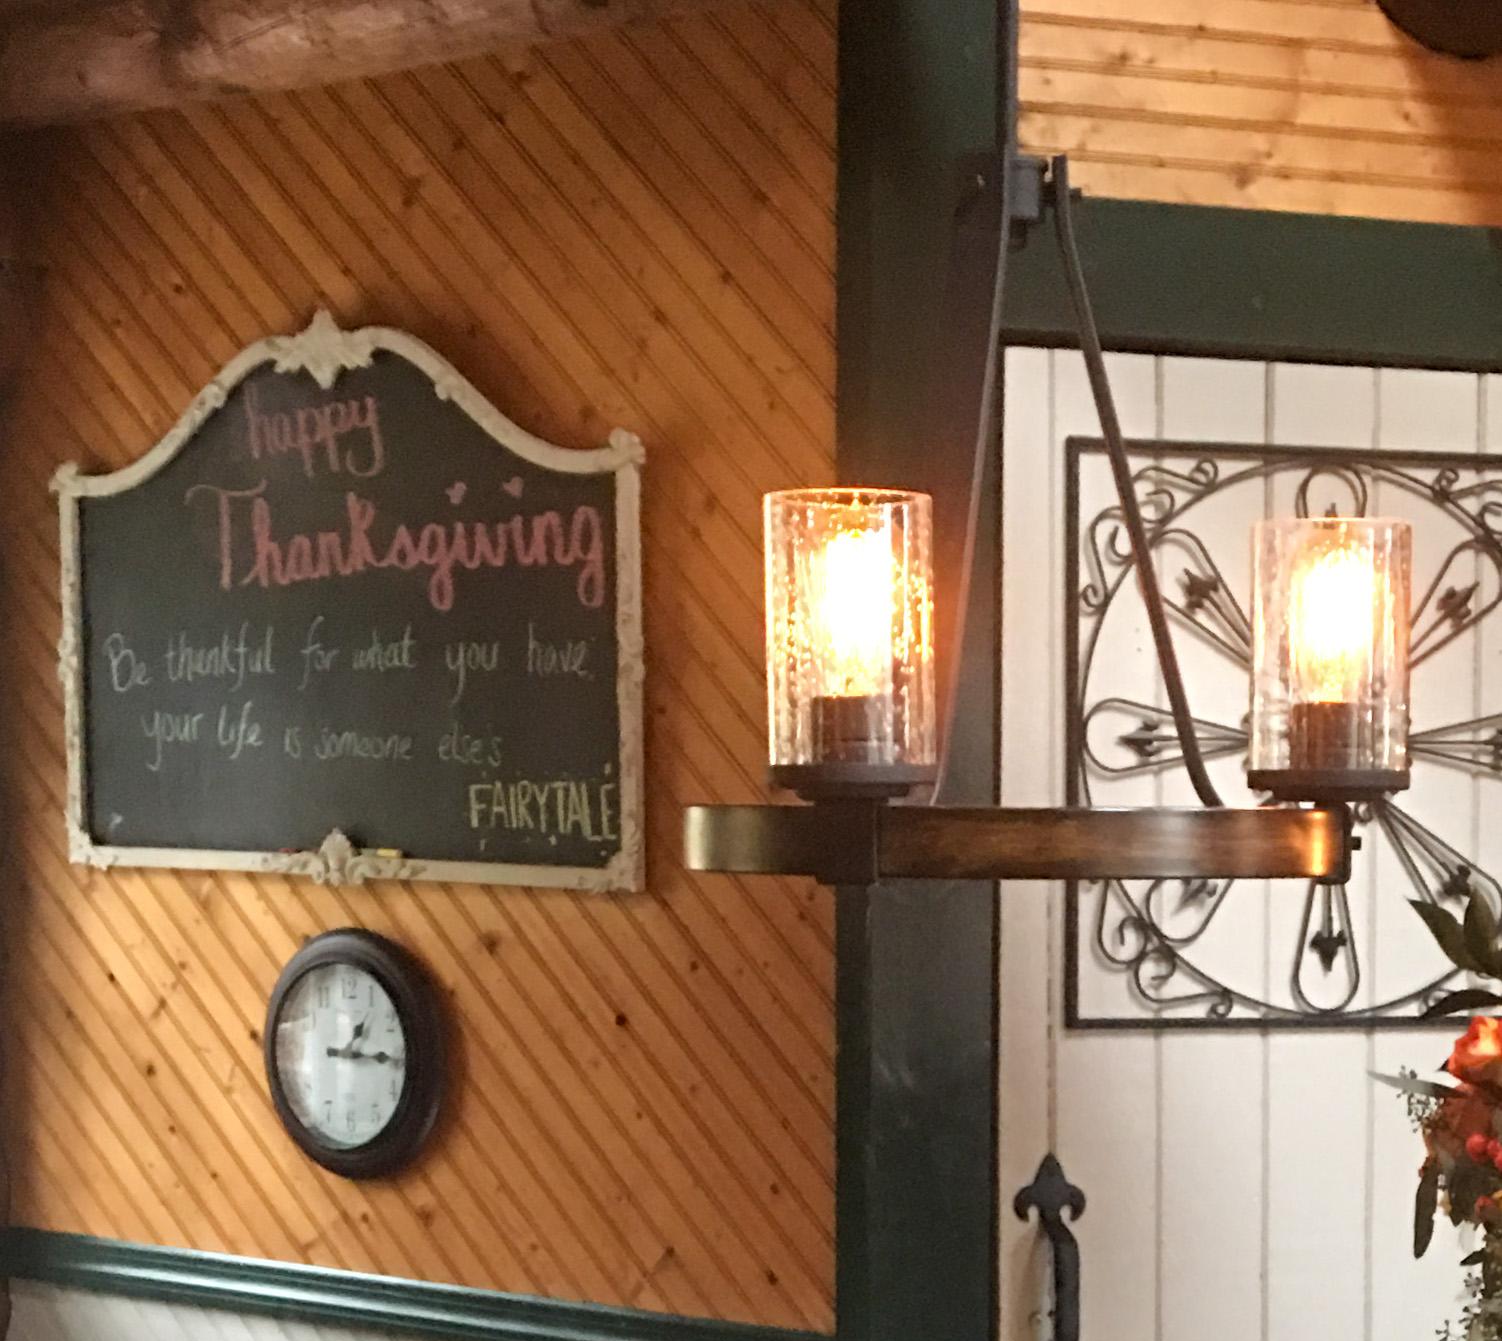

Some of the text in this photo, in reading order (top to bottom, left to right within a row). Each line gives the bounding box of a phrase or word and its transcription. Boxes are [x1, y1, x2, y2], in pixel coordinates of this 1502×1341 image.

[244, 382, 386, 478] happy
[185, 477, 605, 611] Thanksgiving
[105, 632, 150, 693] Be
[164, 622, 275, 692] thankful
[300, 616, 340, 690] for
[352, 624, 416, 672] what
[445, 641, 500, 704] you
[141, 710, 204, 772] your
[217, 701, 264, 760] life
[284, 723, 302, 760] is
[313, 727, 414, 761] someone
[469, 780, 619, 843] FAIRYTALE
